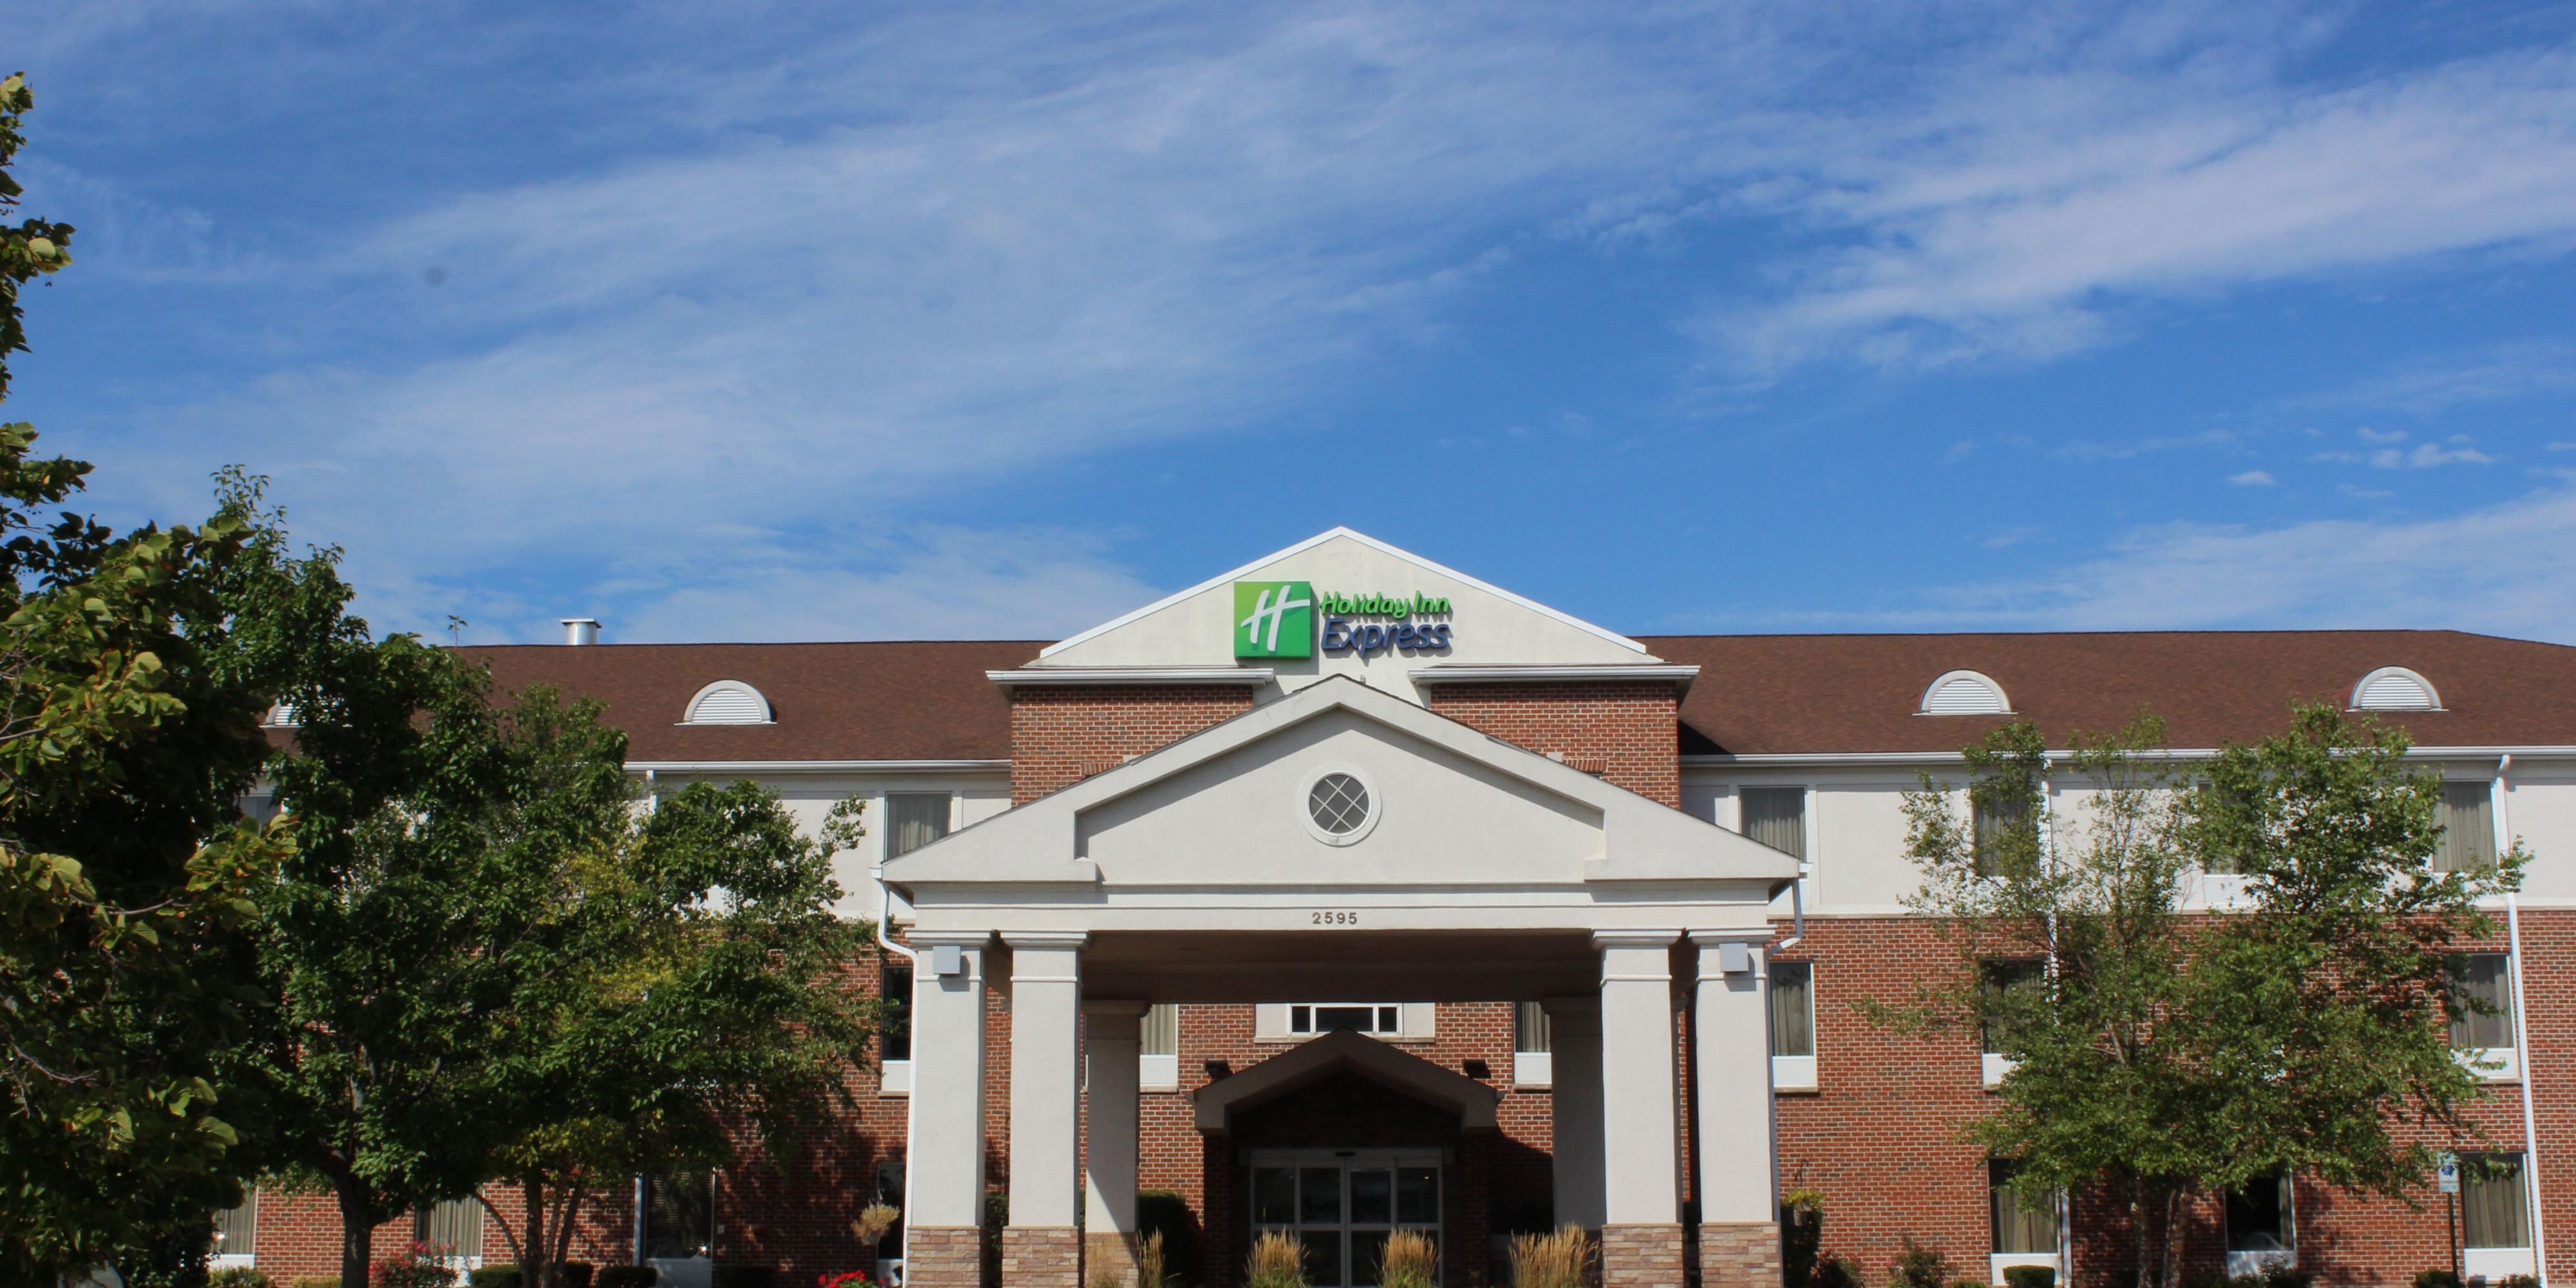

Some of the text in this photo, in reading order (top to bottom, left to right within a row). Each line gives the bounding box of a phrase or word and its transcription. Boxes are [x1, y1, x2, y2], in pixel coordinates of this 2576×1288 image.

[1240, 585, 1310, 651] H
[1320, 590, 1450, 619] Holiday Inn
[1321, 617, 1450, 657] Express
[1312, 911, 1358, 925] 2595
